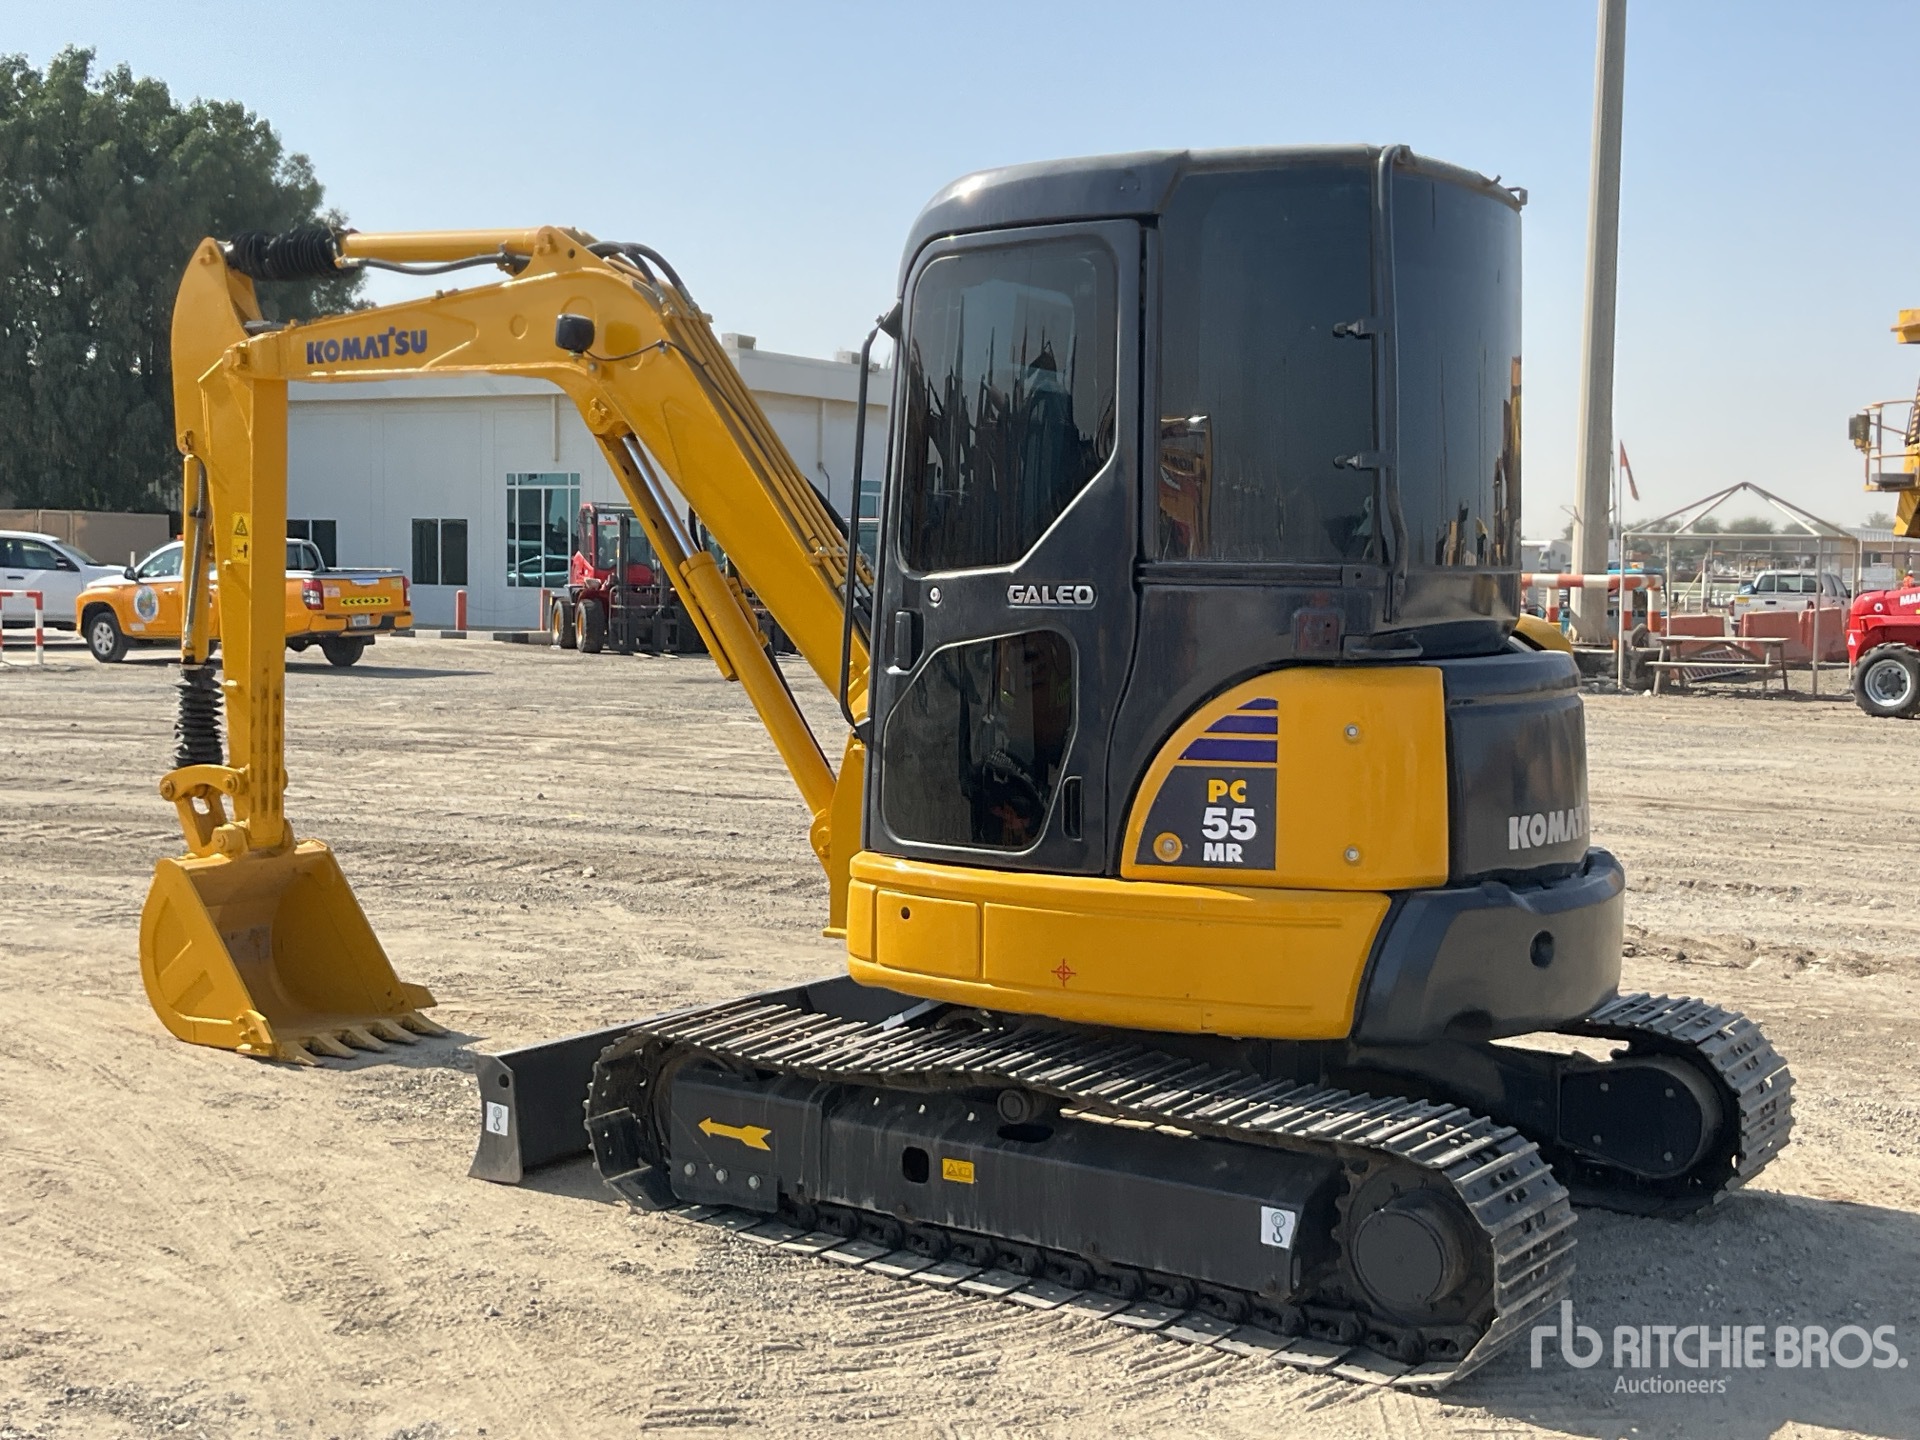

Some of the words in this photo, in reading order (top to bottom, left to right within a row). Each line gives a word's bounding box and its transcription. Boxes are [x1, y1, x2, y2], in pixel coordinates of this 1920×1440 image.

[306, 326, 428, 365] KOMATSU
[1007, 585, 1094, 605] GALEO
[1208, 779, 1247, 804] PC
[1202, 807, 1257, 841] 55
[1204, 843, 1243, 863] MR
